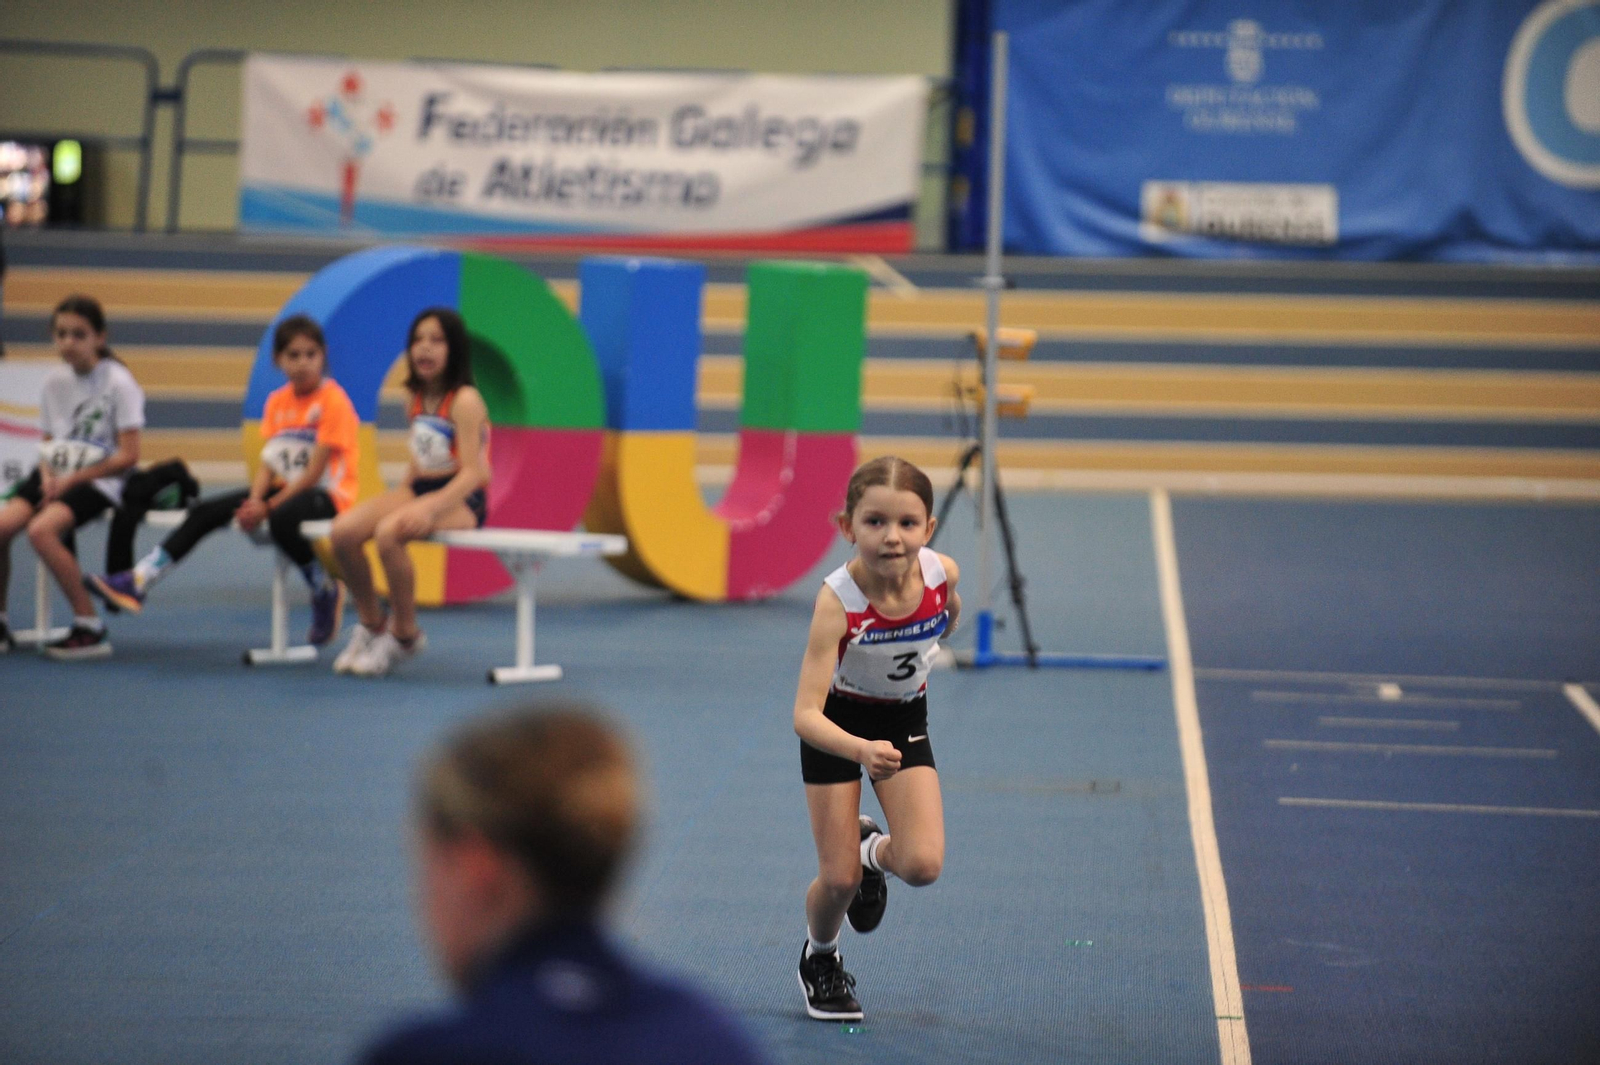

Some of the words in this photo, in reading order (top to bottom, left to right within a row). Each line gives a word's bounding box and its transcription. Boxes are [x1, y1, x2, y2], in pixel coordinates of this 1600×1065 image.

[417, 89, 657, 144] Federación
[669, 103, 861, 170] Galega
[414, 164, 467, 201] de
[481, 157, 720, 206] Atletismo
[279, 447, 310, 472] 14
[863, 625, 921, 643] URENSE
[887, 651, 918, 682] 3
